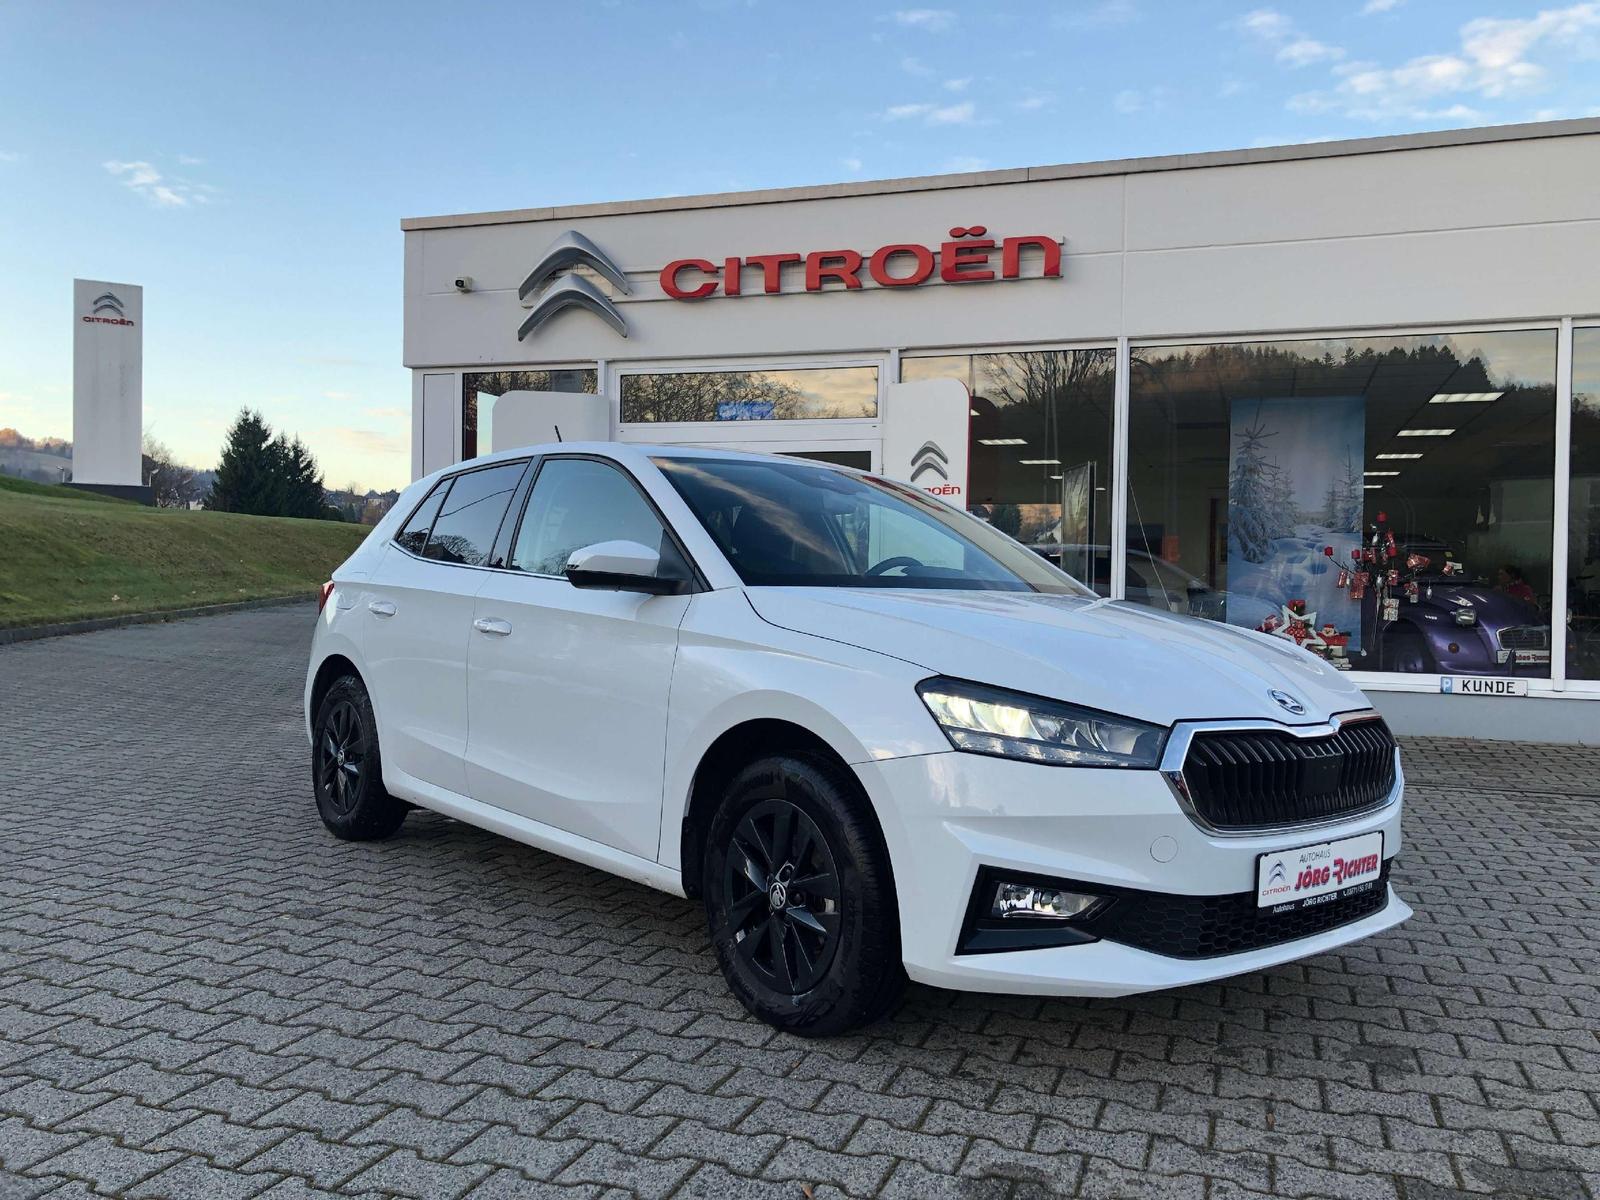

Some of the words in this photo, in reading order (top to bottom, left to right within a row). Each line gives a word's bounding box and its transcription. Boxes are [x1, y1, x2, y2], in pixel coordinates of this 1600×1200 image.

[659, 225, 1062, 299] CITROËN
[1462, 680, 1515, 694] KUNDE
[1299, 850, 1331, 863] AUTOHAUS
[1294, 865, 1331, 891] JÖRG
[1332, 855, 1379, 885] RICHTER
